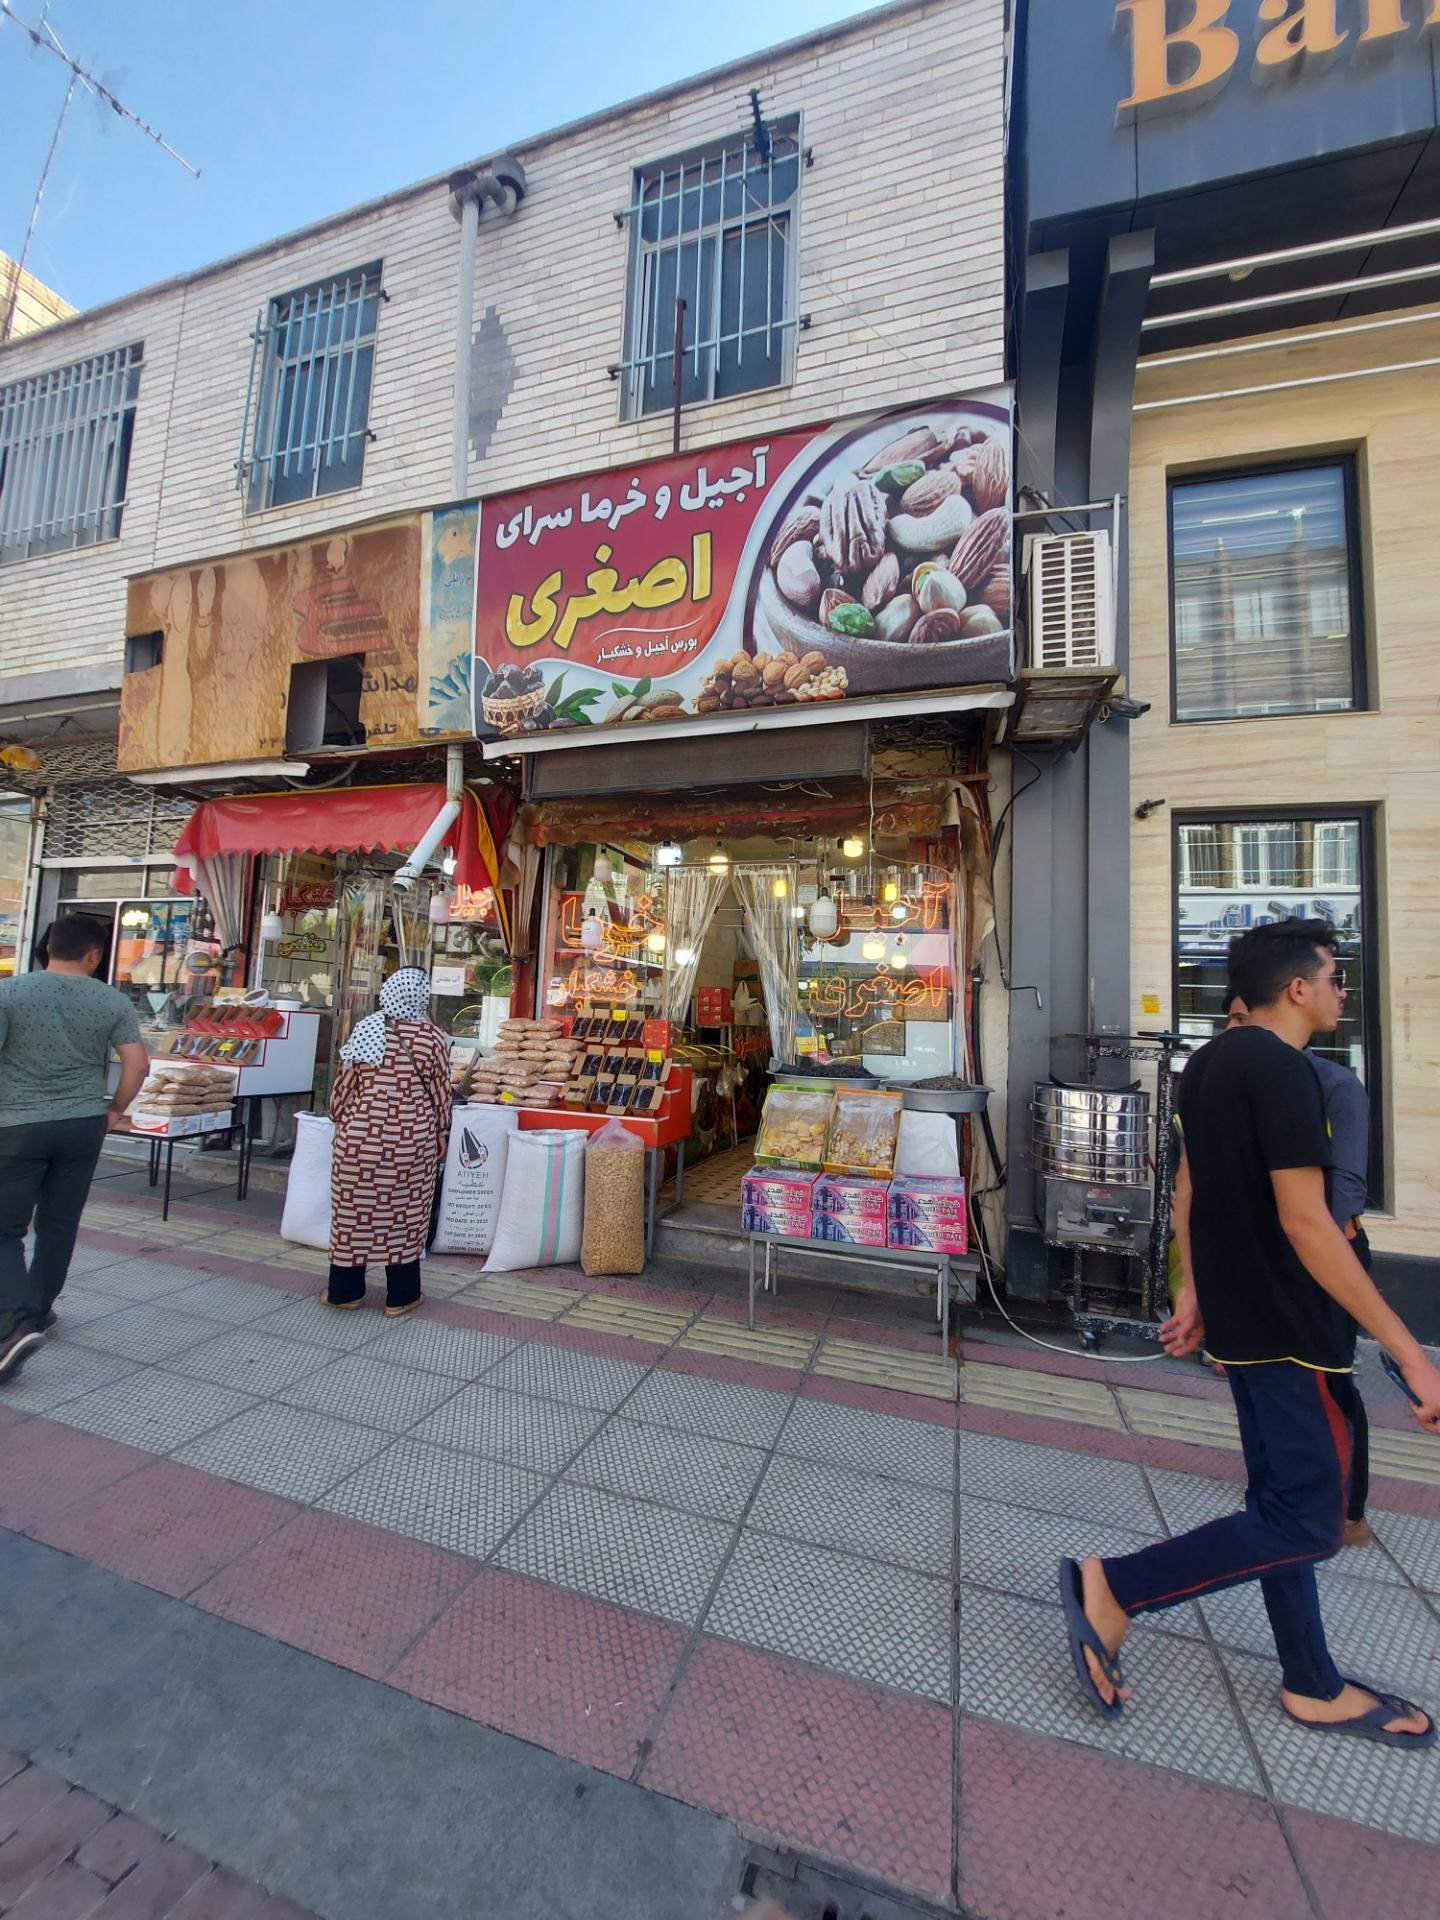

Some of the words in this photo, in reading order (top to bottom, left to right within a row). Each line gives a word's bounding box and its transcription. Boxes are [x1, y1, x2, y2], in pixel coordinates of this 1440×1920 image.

[654, 483, 672, 519] و
[680, 446, 771, 512] آجیل
[580, 477, 647, 530] خرما
[496, 505, 573, 549] سرای
[505, 532, 713, 649] اصغری
[635, 645, 642, 658] و
[671, 637, 698, 654] بورس
[808, 961, 944, 1017] اصغری
[457, 1169, 489, 1180] ATIYEH
